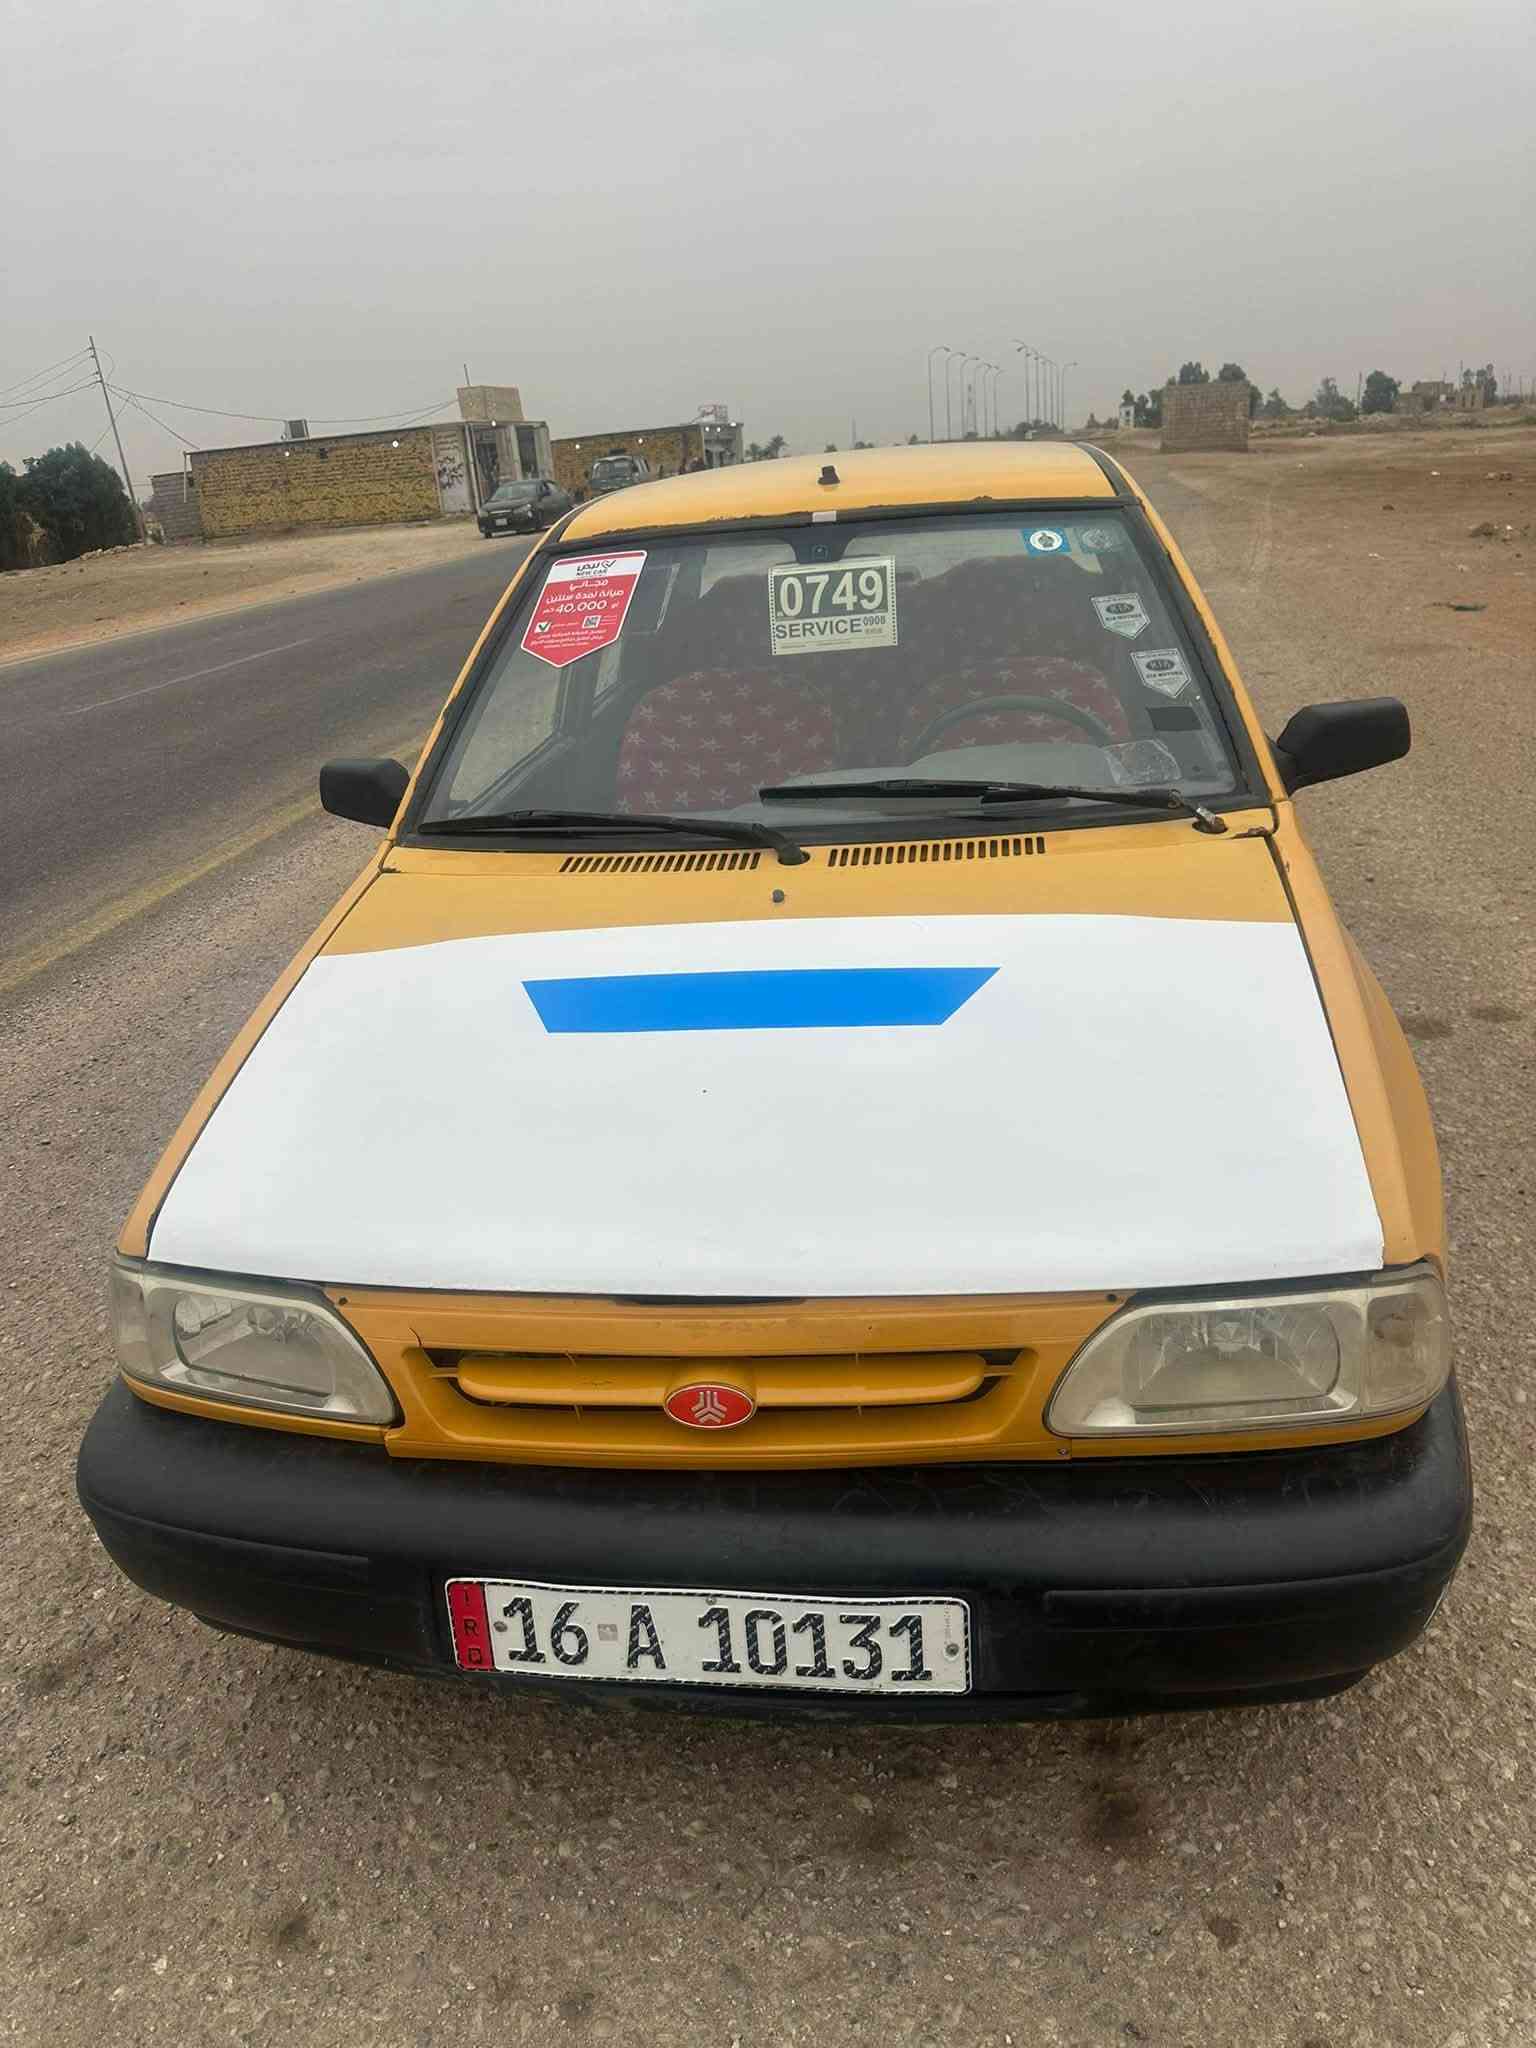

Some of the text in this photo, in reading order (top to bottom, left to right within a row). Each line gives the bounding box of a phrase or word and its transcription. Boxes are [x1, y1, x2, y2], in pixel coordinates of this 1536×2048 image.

[556, 599, 608, 615] 40,000
[779, 569, 884, 617] 0749
[775, 617, 863, 639] SERVICE
[502, 1597, 589, 1666] 16
[626, 1604, 667, 1669] A
[697, 1606, 933, 1681] 10131
